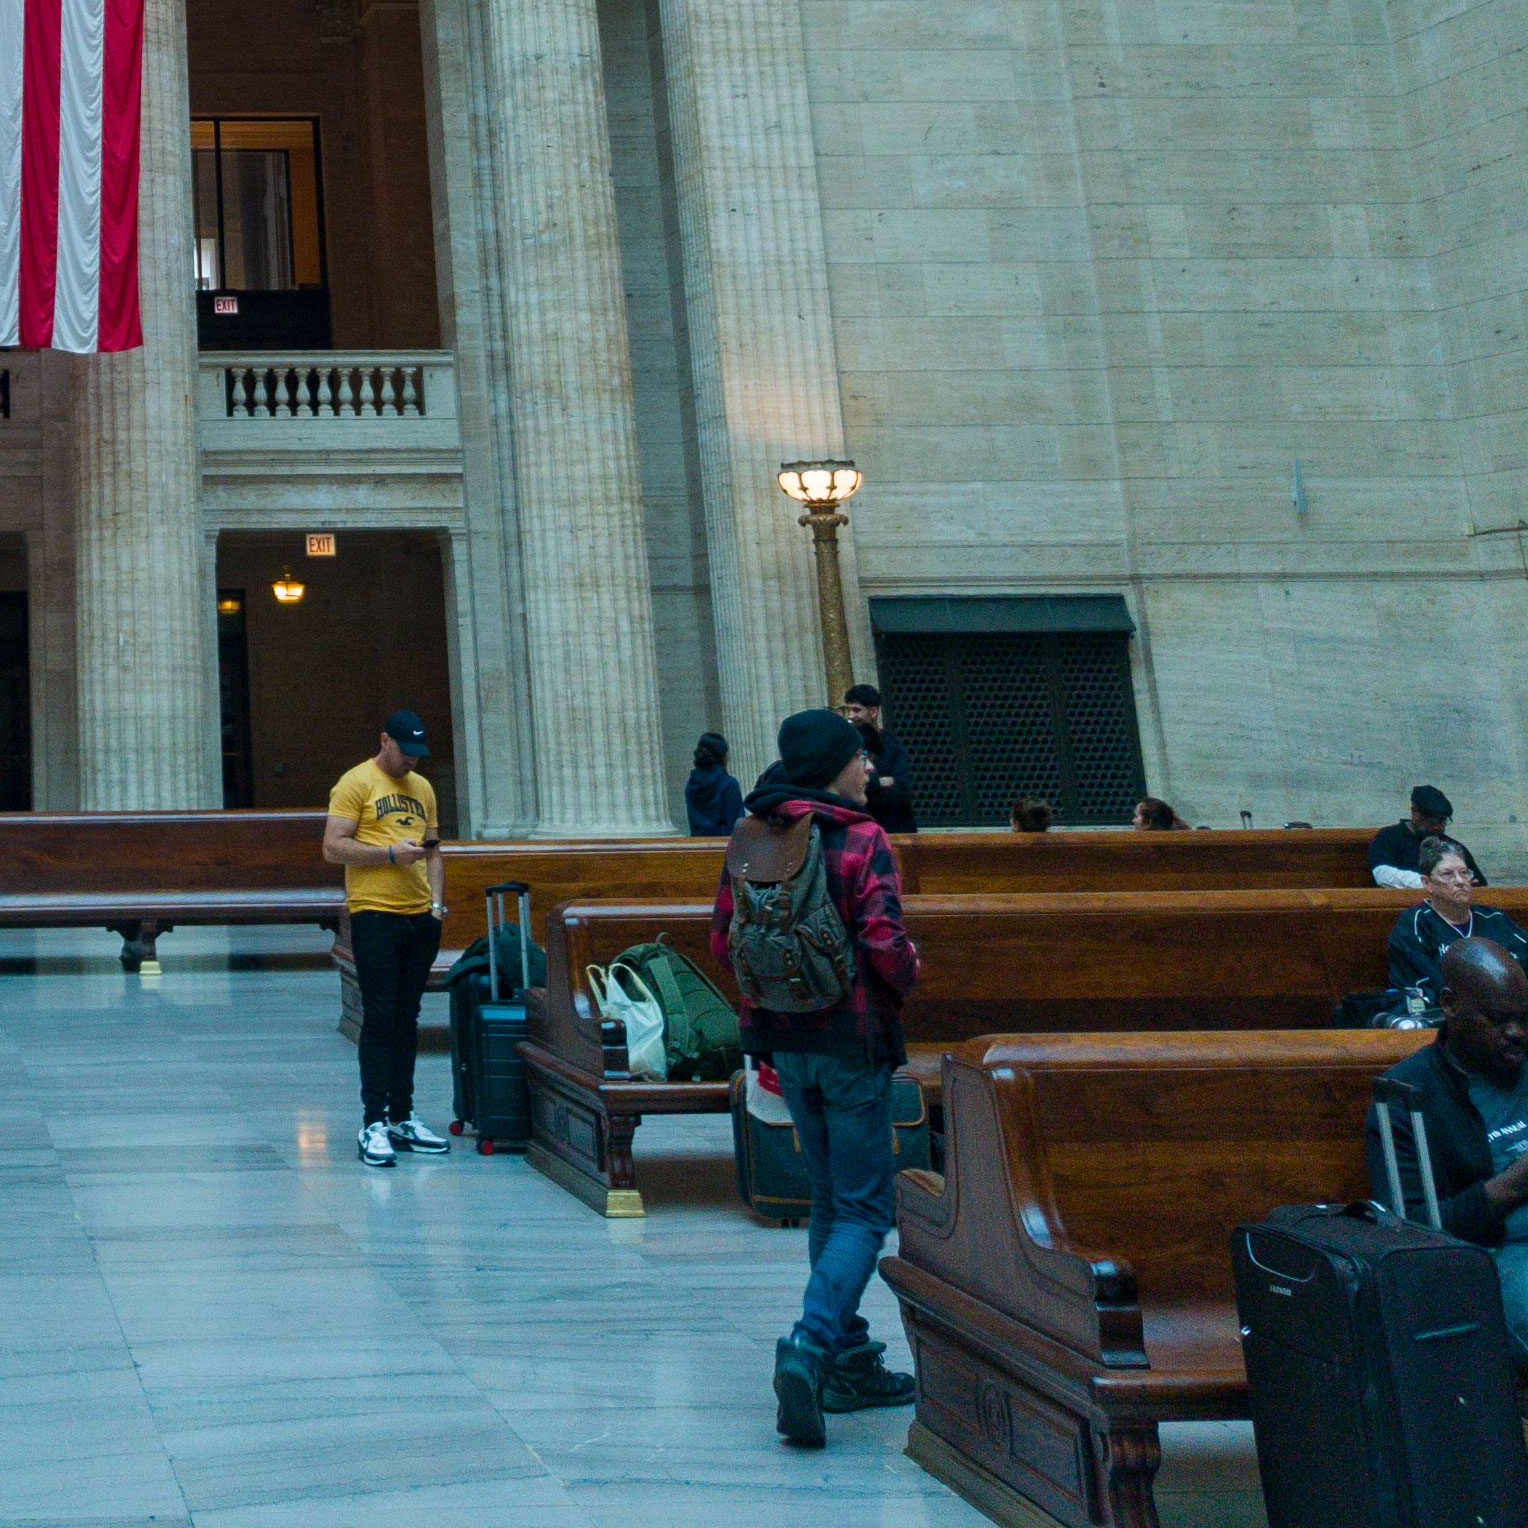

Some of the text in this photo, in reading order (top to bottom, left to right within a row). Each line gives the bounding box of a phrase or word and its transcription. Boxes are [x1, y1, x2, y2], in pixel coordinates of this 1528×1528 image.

[216, 299, 236, 312] EXIT
[309, 537, 332, 553] EXIT
[375, 793, 427, 821] HOLLISTER
